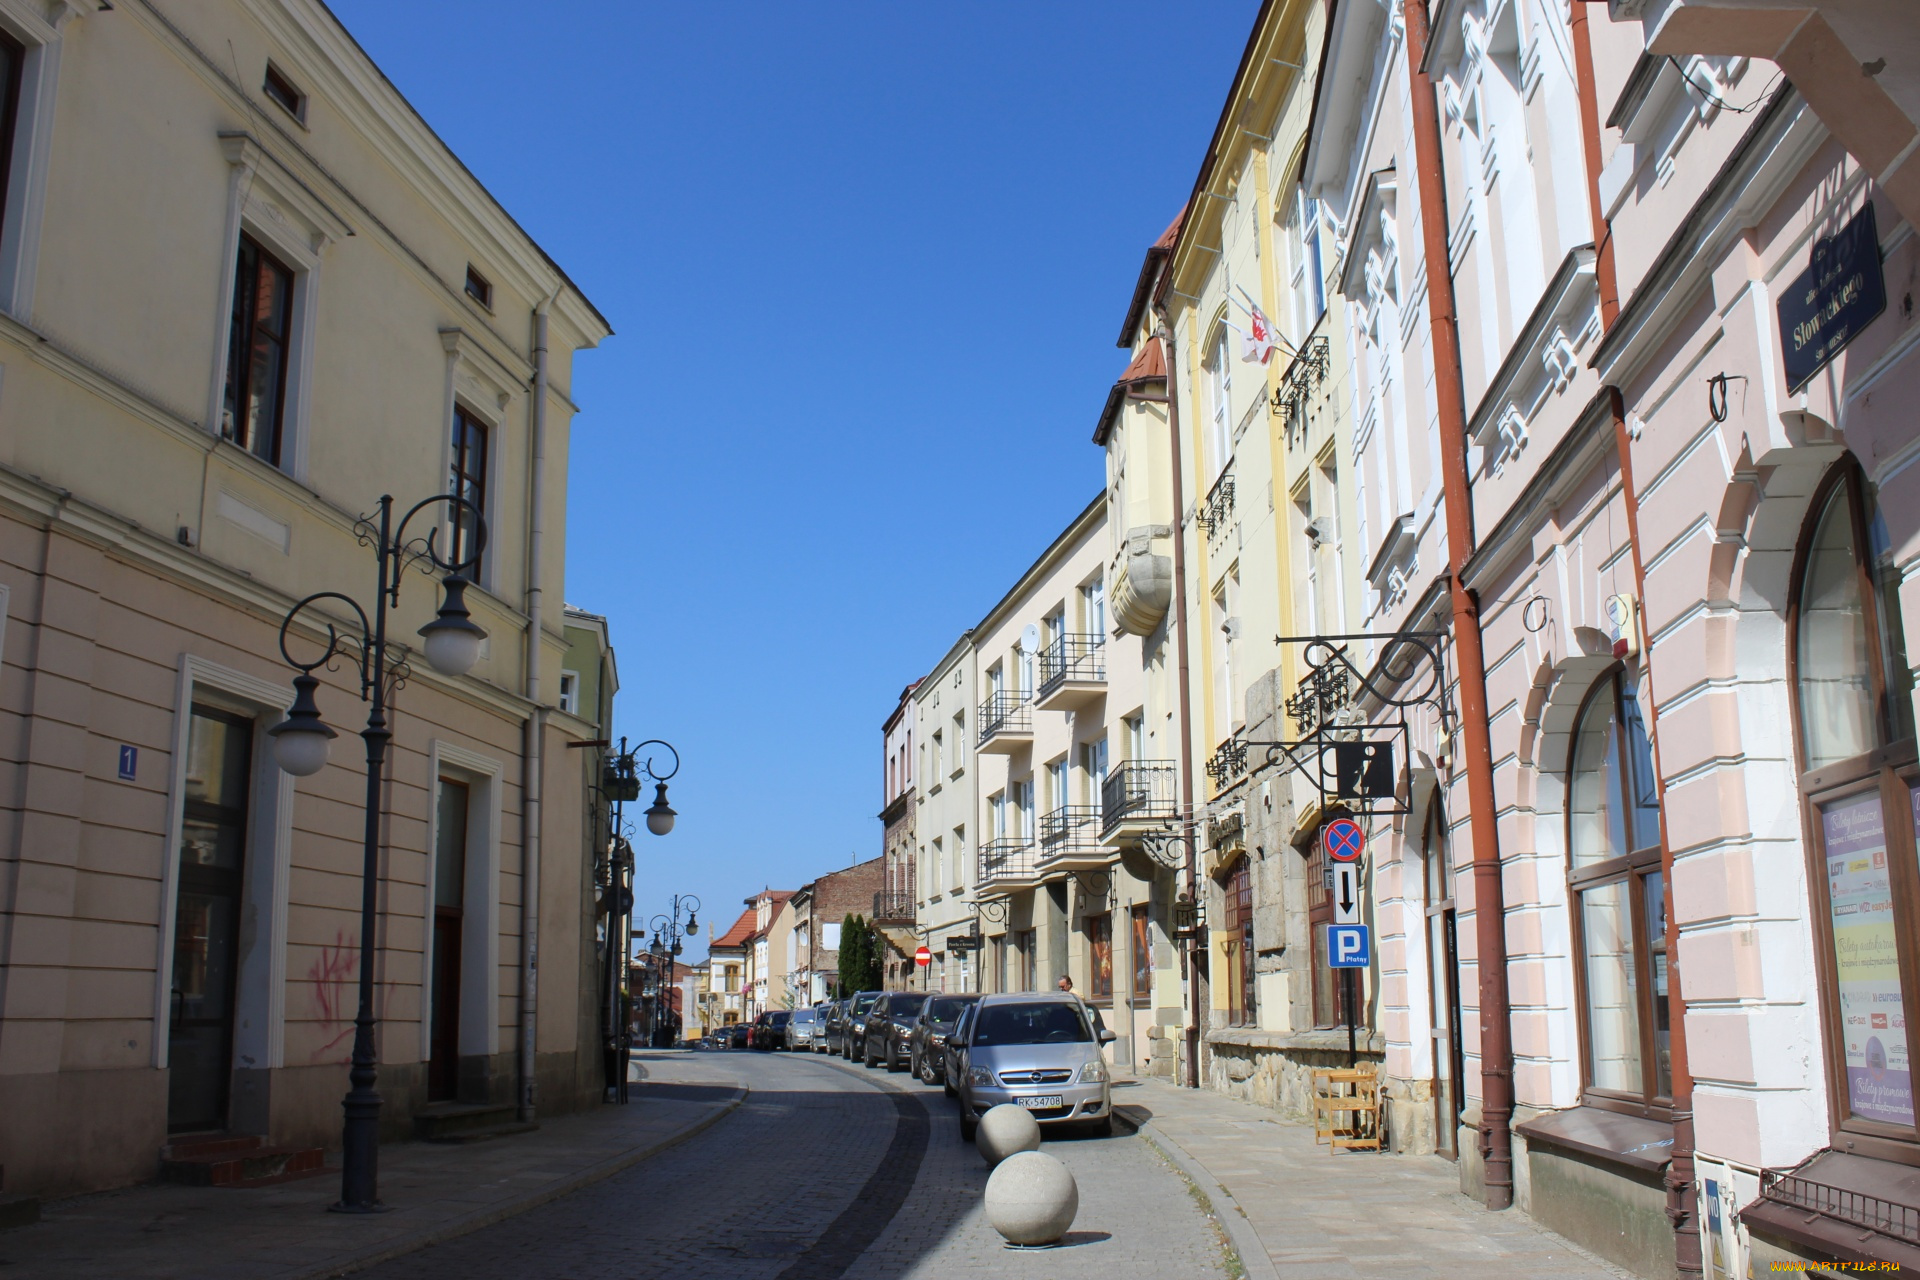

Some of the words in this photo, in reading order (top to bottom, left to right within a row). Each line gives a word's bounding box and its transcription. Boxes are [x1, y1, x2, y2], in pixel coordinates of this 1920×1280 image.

[1793, 272, 1863, 352] Słowackiego
[125, 749, 131, 773] 1
[1831, 813, 1851, 836] Bilety
[1831, 861, 1845, 876] LOT
[1837, 904, 1857, 914] RYANAIR
[1337, 930, 1361, 963] P
[1838, 937, 1858, 960] Bilety
[1346, 956, 1367, 964] Płatny
[1034, 1096, 1061, 1106] 54708
[1856, 1078, 1877, 1103] Bilety
[1878, 1085, 1909, 1104] promowe
[1854, 1098, 1871, 1110] krajowe
